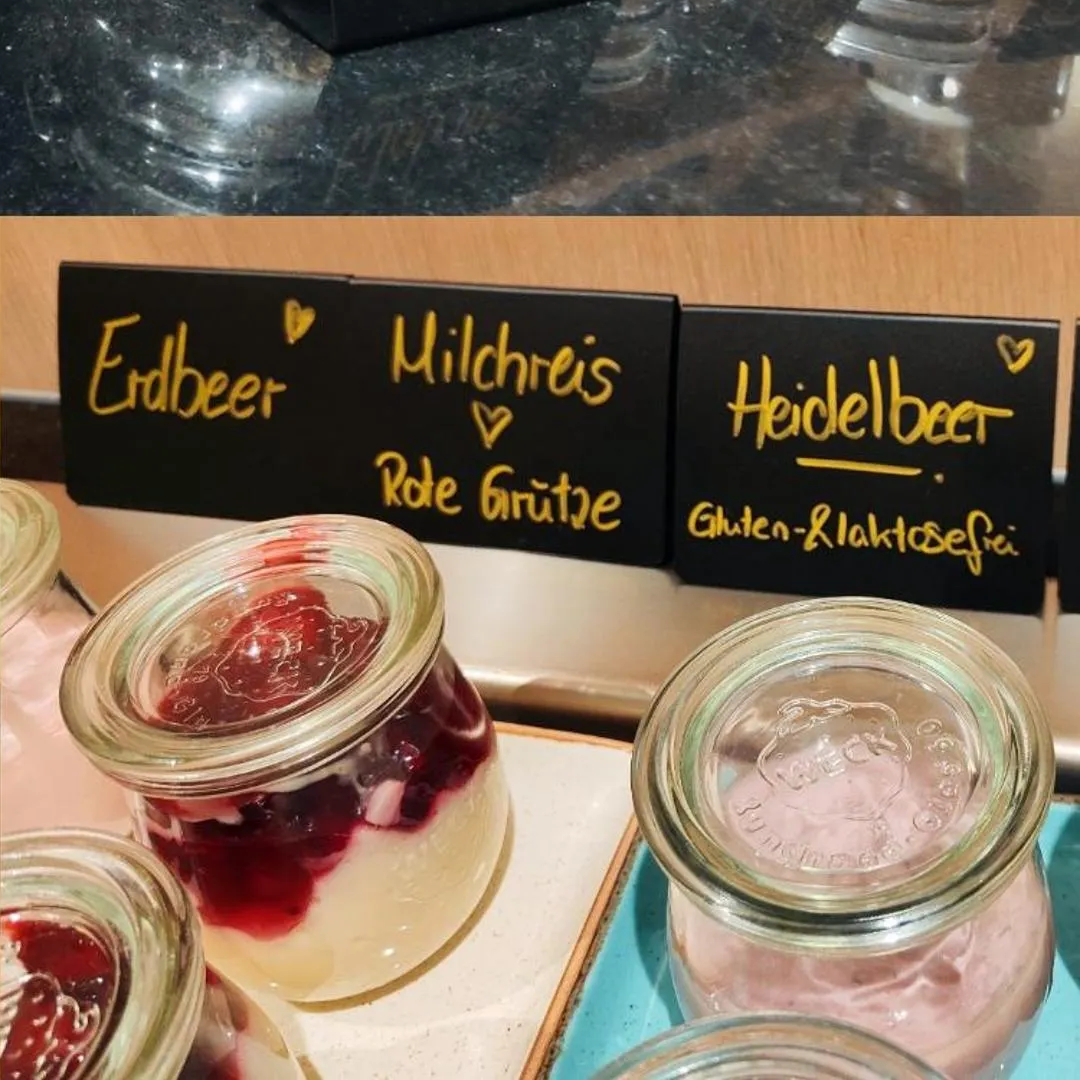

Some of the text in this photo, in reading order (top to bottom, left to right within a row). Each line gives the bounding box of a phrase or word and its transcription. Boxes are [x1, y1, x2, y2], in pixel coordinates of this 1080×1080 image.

[87, 312, 288, 419] Erdbeer
[391, 309, 622, 407] Milchreis
[726, 353, 1015, 451] Heidelbeer
[373, 450, 622, 533] Rote Grütze
